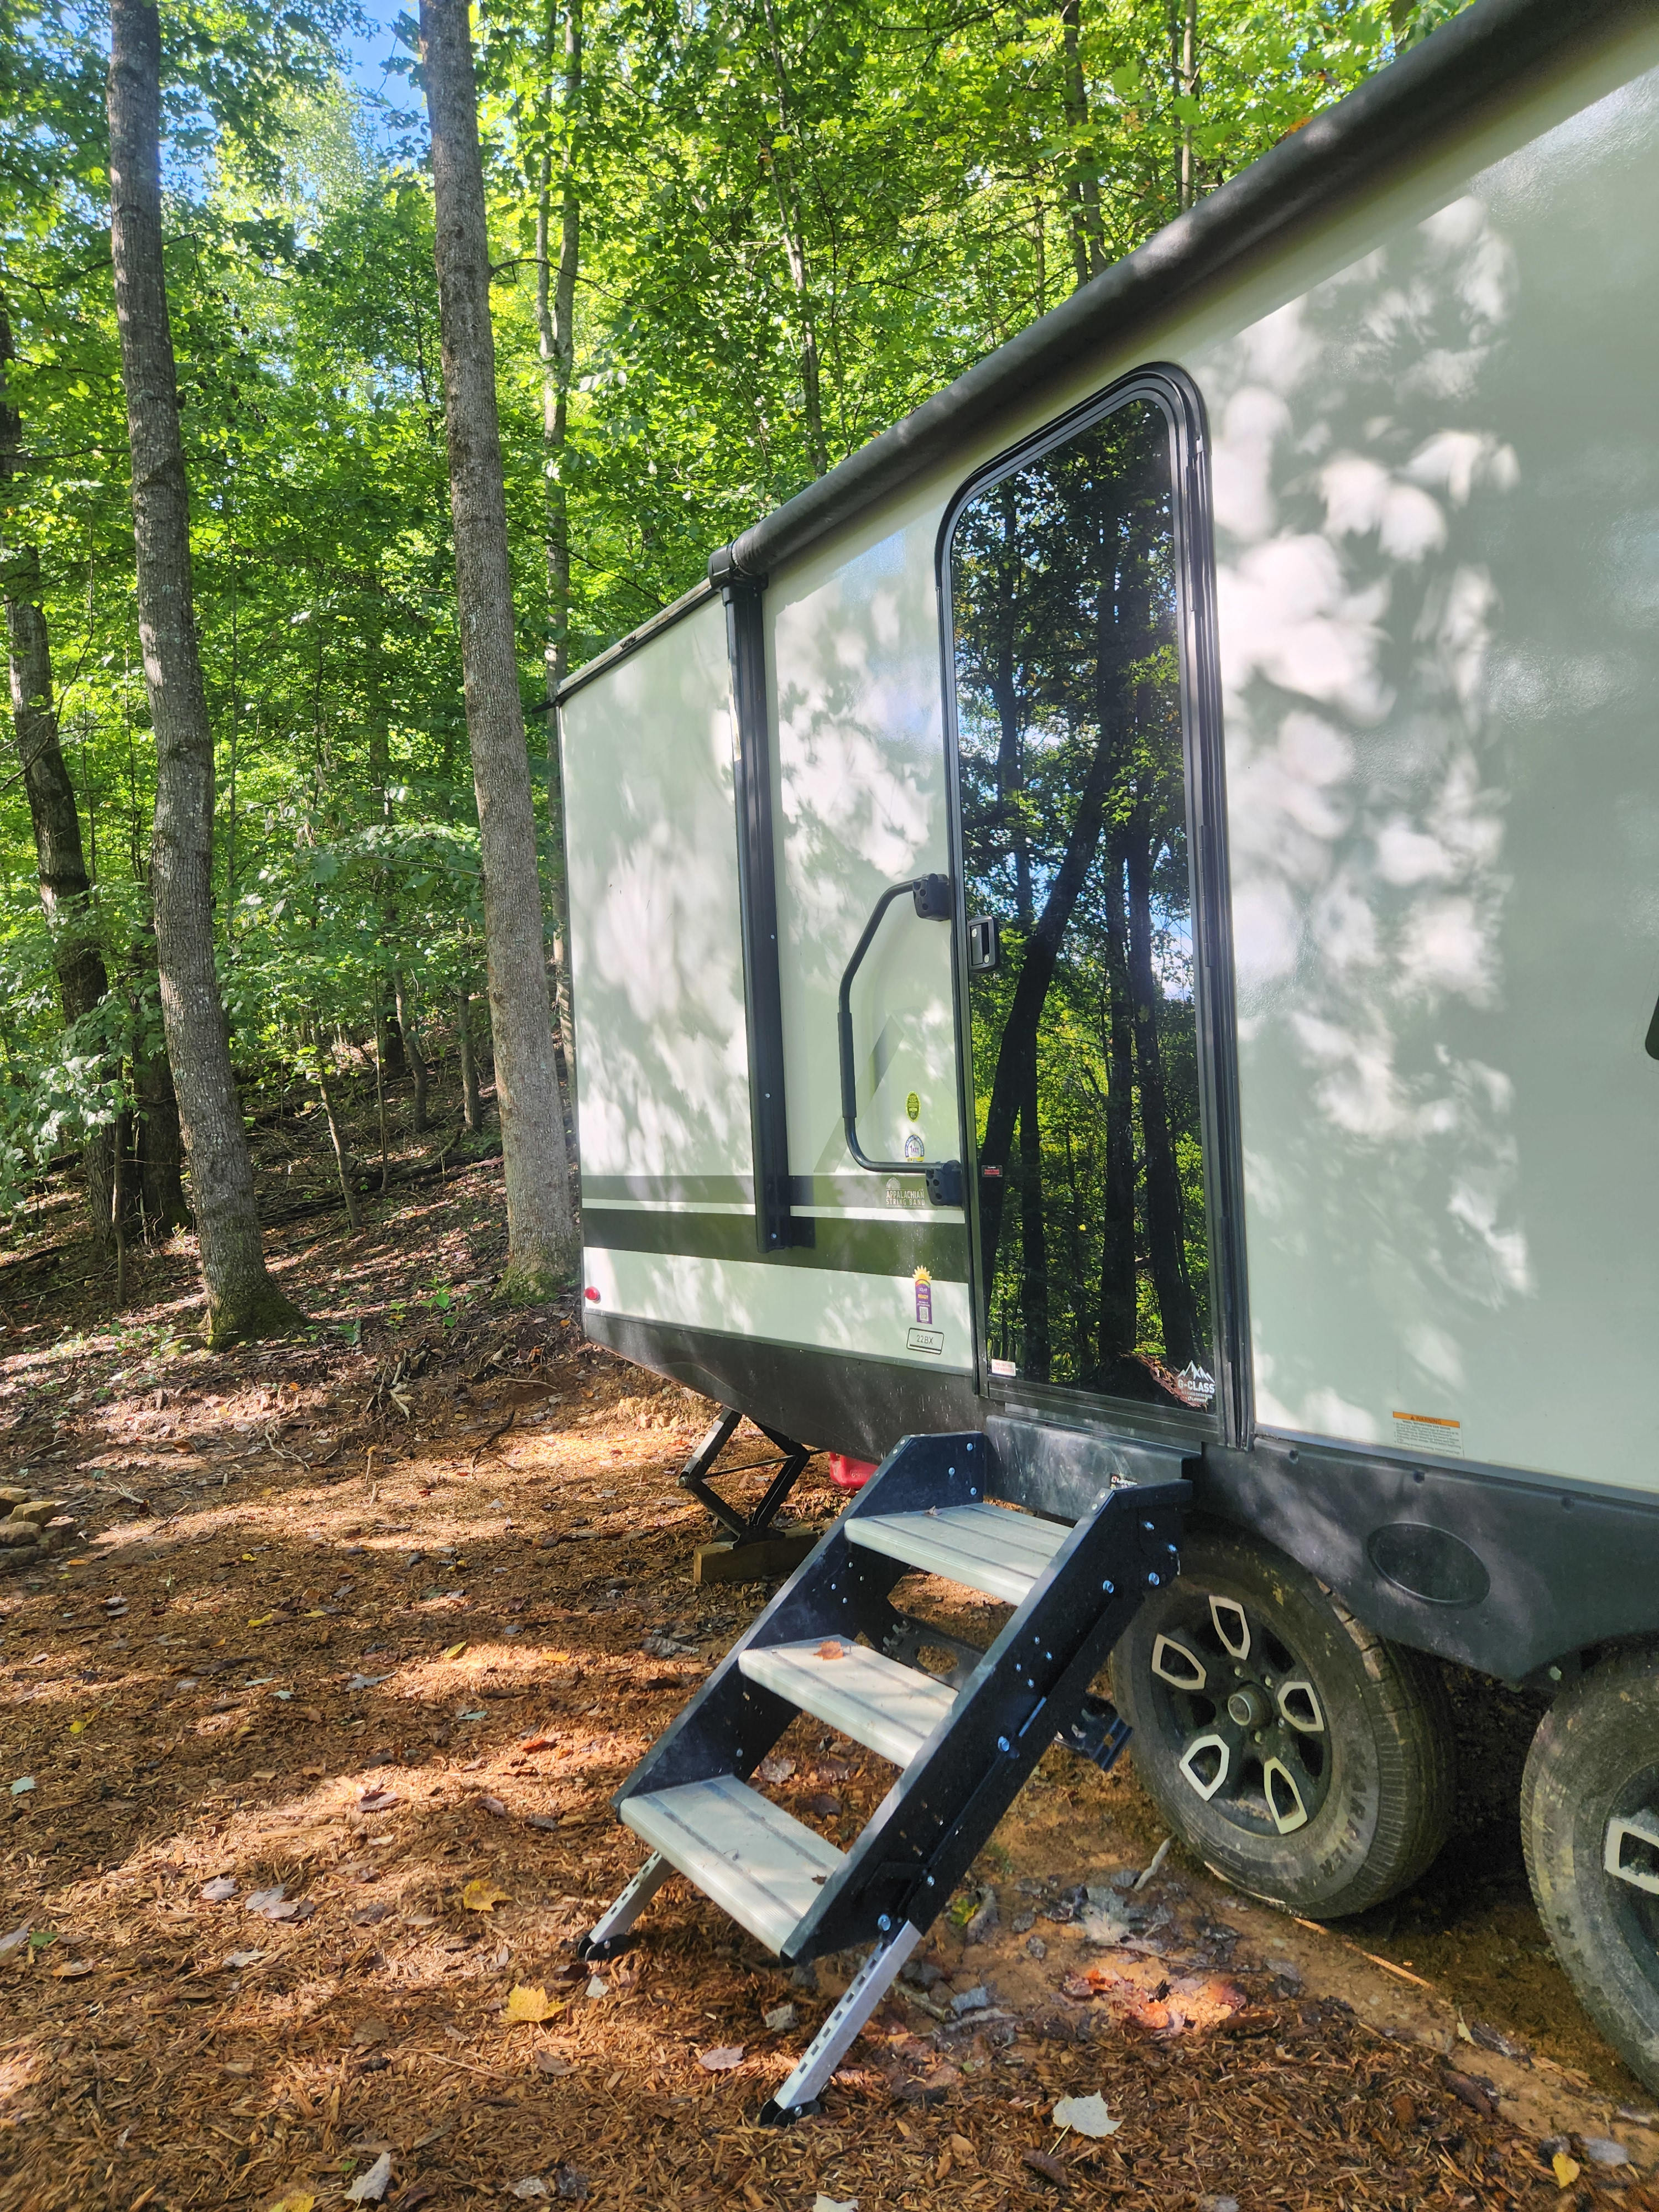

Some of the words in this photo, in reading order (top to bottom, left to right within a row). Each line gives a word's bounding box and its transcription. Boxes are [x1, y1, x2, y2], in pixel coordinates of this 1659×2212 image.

[886, 1190, 925, 1199] APPALACHIAN
[917, 1335, 933, 1344] 22BX
[1178, 1379, 1215, 1394] G-CLASS
[1415, 1416, 1442, 1425] WARNING
